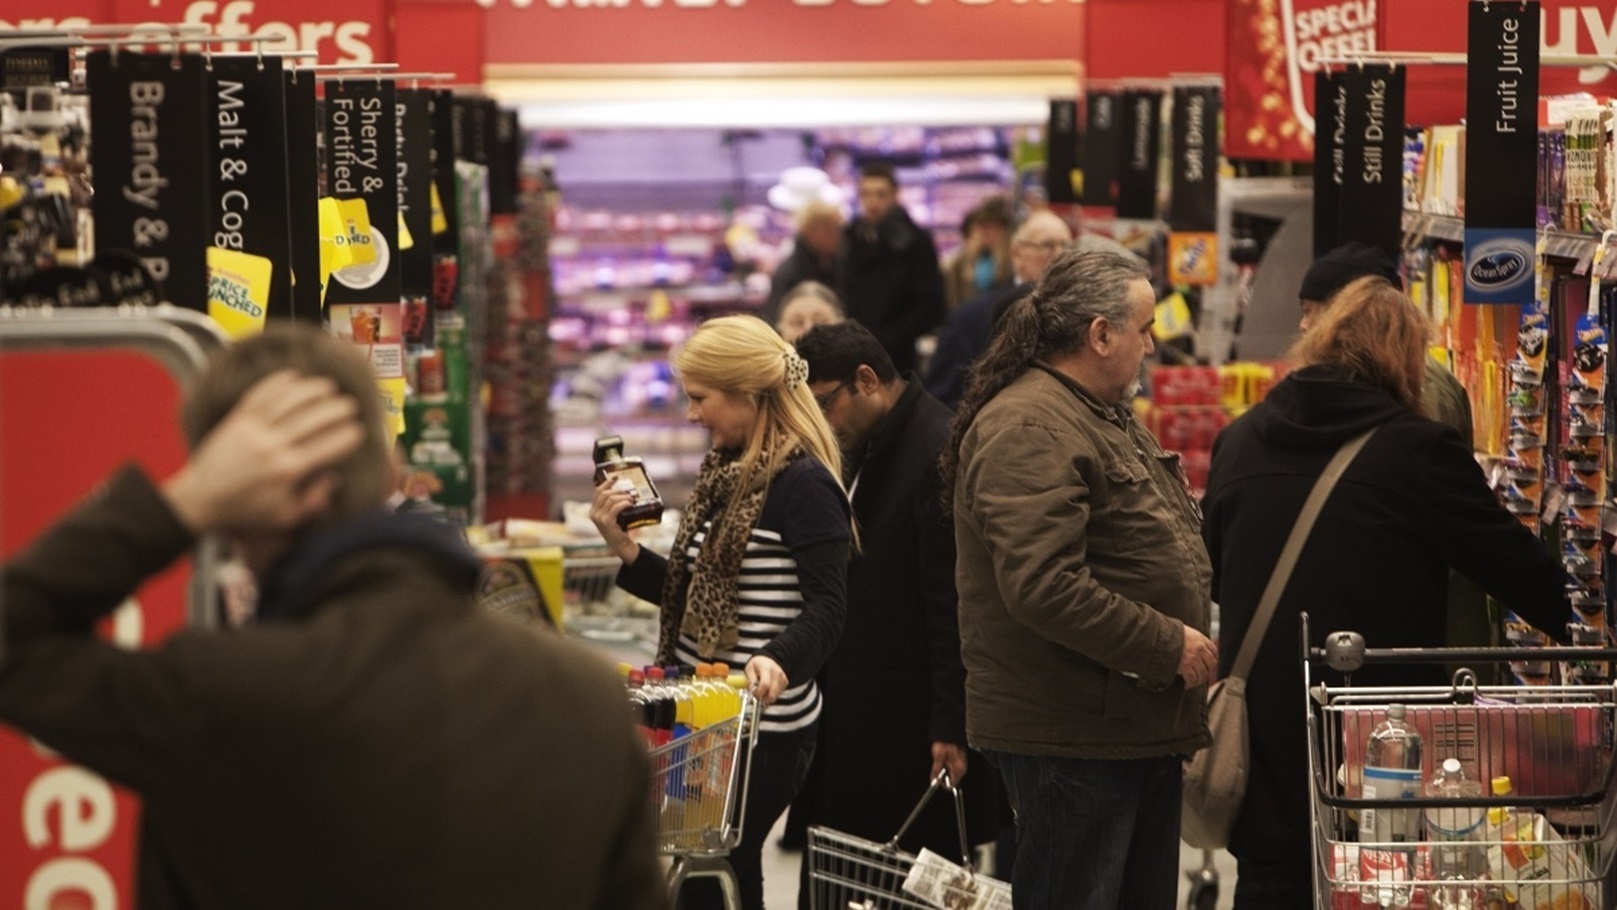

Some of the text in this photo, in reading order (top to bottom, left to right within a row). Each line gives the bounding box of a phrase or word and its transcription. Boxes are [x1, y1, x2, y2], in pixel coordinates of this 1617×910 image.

[127, 1, 374, 68] offers
[1496, 18, 1522, 132] Fruit Juice
[217, 80, 248, 149] Malt
[333, 99, 357, 193] Fortified
[359, 98, 384, 193] Sherry &
[1184, 95, 1205, 182] Soft Drinks
[1363, 78, 1386, 184] Still Drinks
[123, 81, 170, 281] Brandy & P
[220, 157, 248, 181] &
[214, 189, 249, 253] Cog
[207, 288, 263, 318] UNCHED
[210, 276, 249, 299] PRICE
